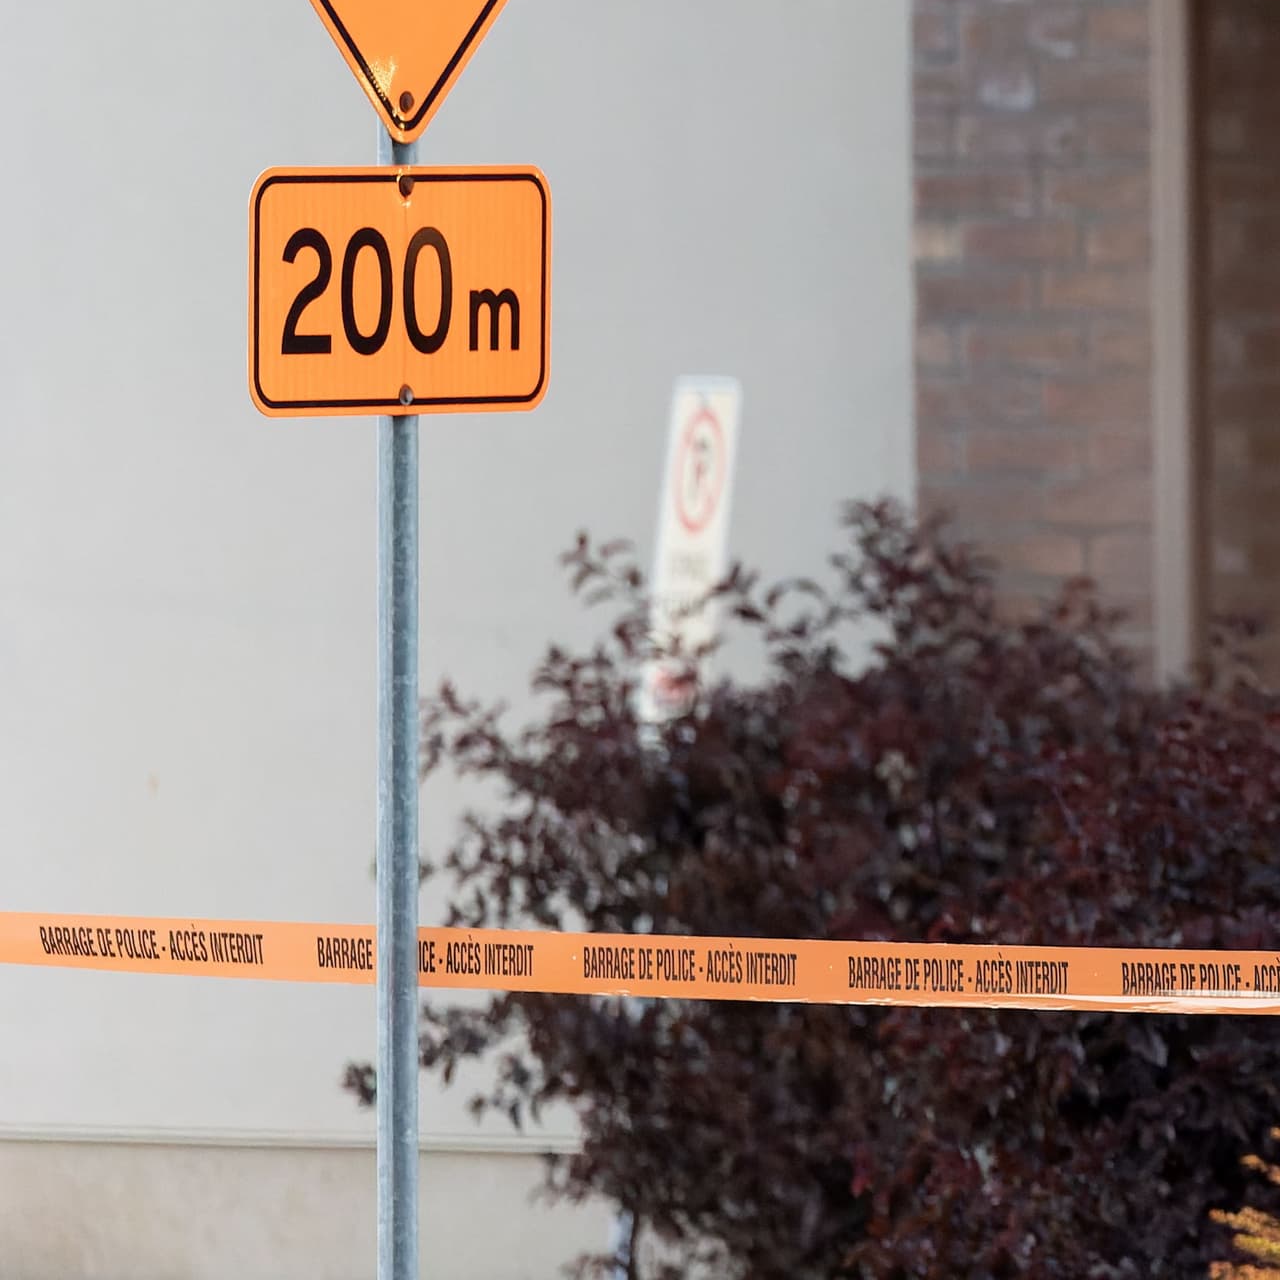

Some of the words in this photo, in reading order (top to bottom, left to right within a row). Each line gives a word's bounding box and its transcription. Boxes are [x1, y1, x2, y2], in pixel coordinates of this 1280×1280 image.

[281, 226, 453, 355] 200
[469, 288, 521, 352] m
[39, 926, 98, 957] BARRAGE
[97, 928, 116, 958] DE
[116, 929, 160, 959] POLICE
[169, 923, 208, 963] ACCÈS
[210, 932, 264, 965] INTERDIT
[317, 937, 373, 970] BARRAGE
[418, 941, 436, 973] ICE
[446, 934, 481, 975] ACCÈS
[484, 943, 534, 977] INTERDIT
[584, 947, 635, 980] BARRAGE
[638, 948, 653, 980] DE
[656, 949, 696, 982] POLICE
[706, 943, 743, 984] ACCÈS
[746, 952, 797, 985] INTERDIT
[848, 956, 902, 990] BARRAGE
[905, 958, 920, 991] DE
[923, 959, 964, 992] POLICE
[975, 952, 1012, 994] ACCÈS
[1015, 961, 1069, 994] INTERDIT
[1121, 962, 1176, 996] BARRAGE
[1180, 963, 1196, 995] DE
[1199, 963, 1241, 997] POLICE
